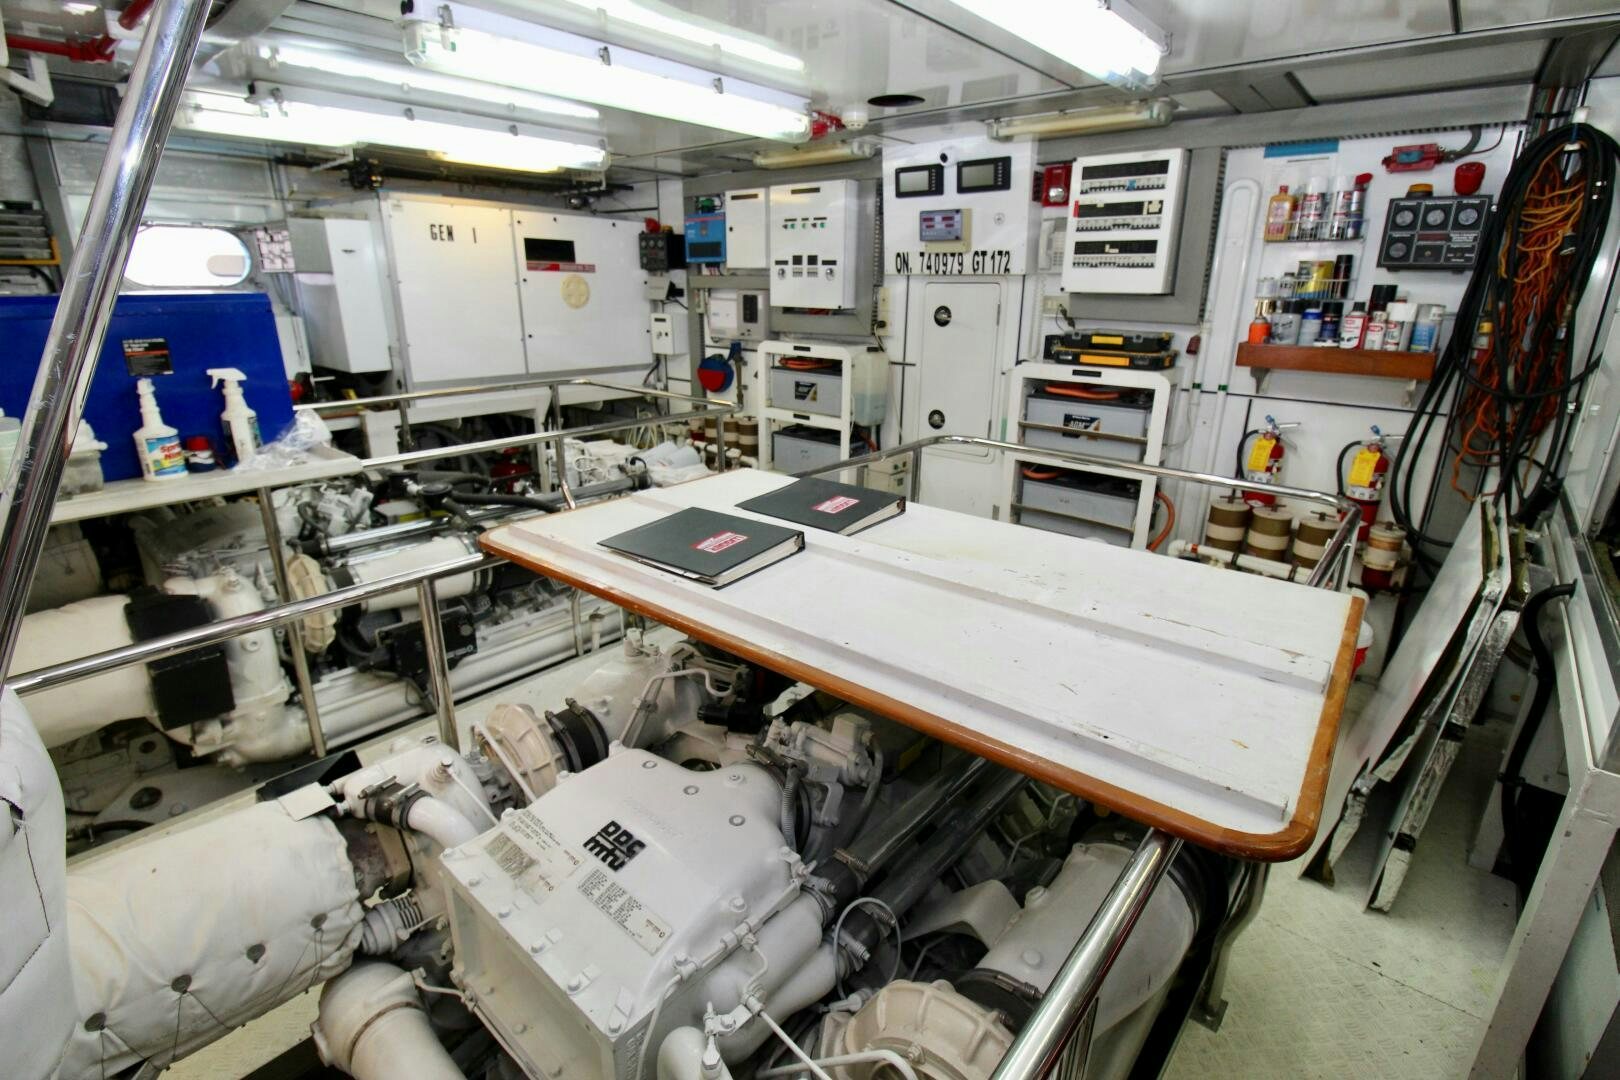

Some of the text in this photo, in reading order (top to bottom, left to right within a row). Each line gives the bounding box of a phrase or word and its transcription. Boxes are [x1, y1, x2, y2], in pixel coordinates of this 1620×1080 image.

[430, 223, 454, 242] GEN
[919, 251, 964, 275] 740979
[972, 250, 988, 274] GT
[991, 250, 1011, 274] 172
